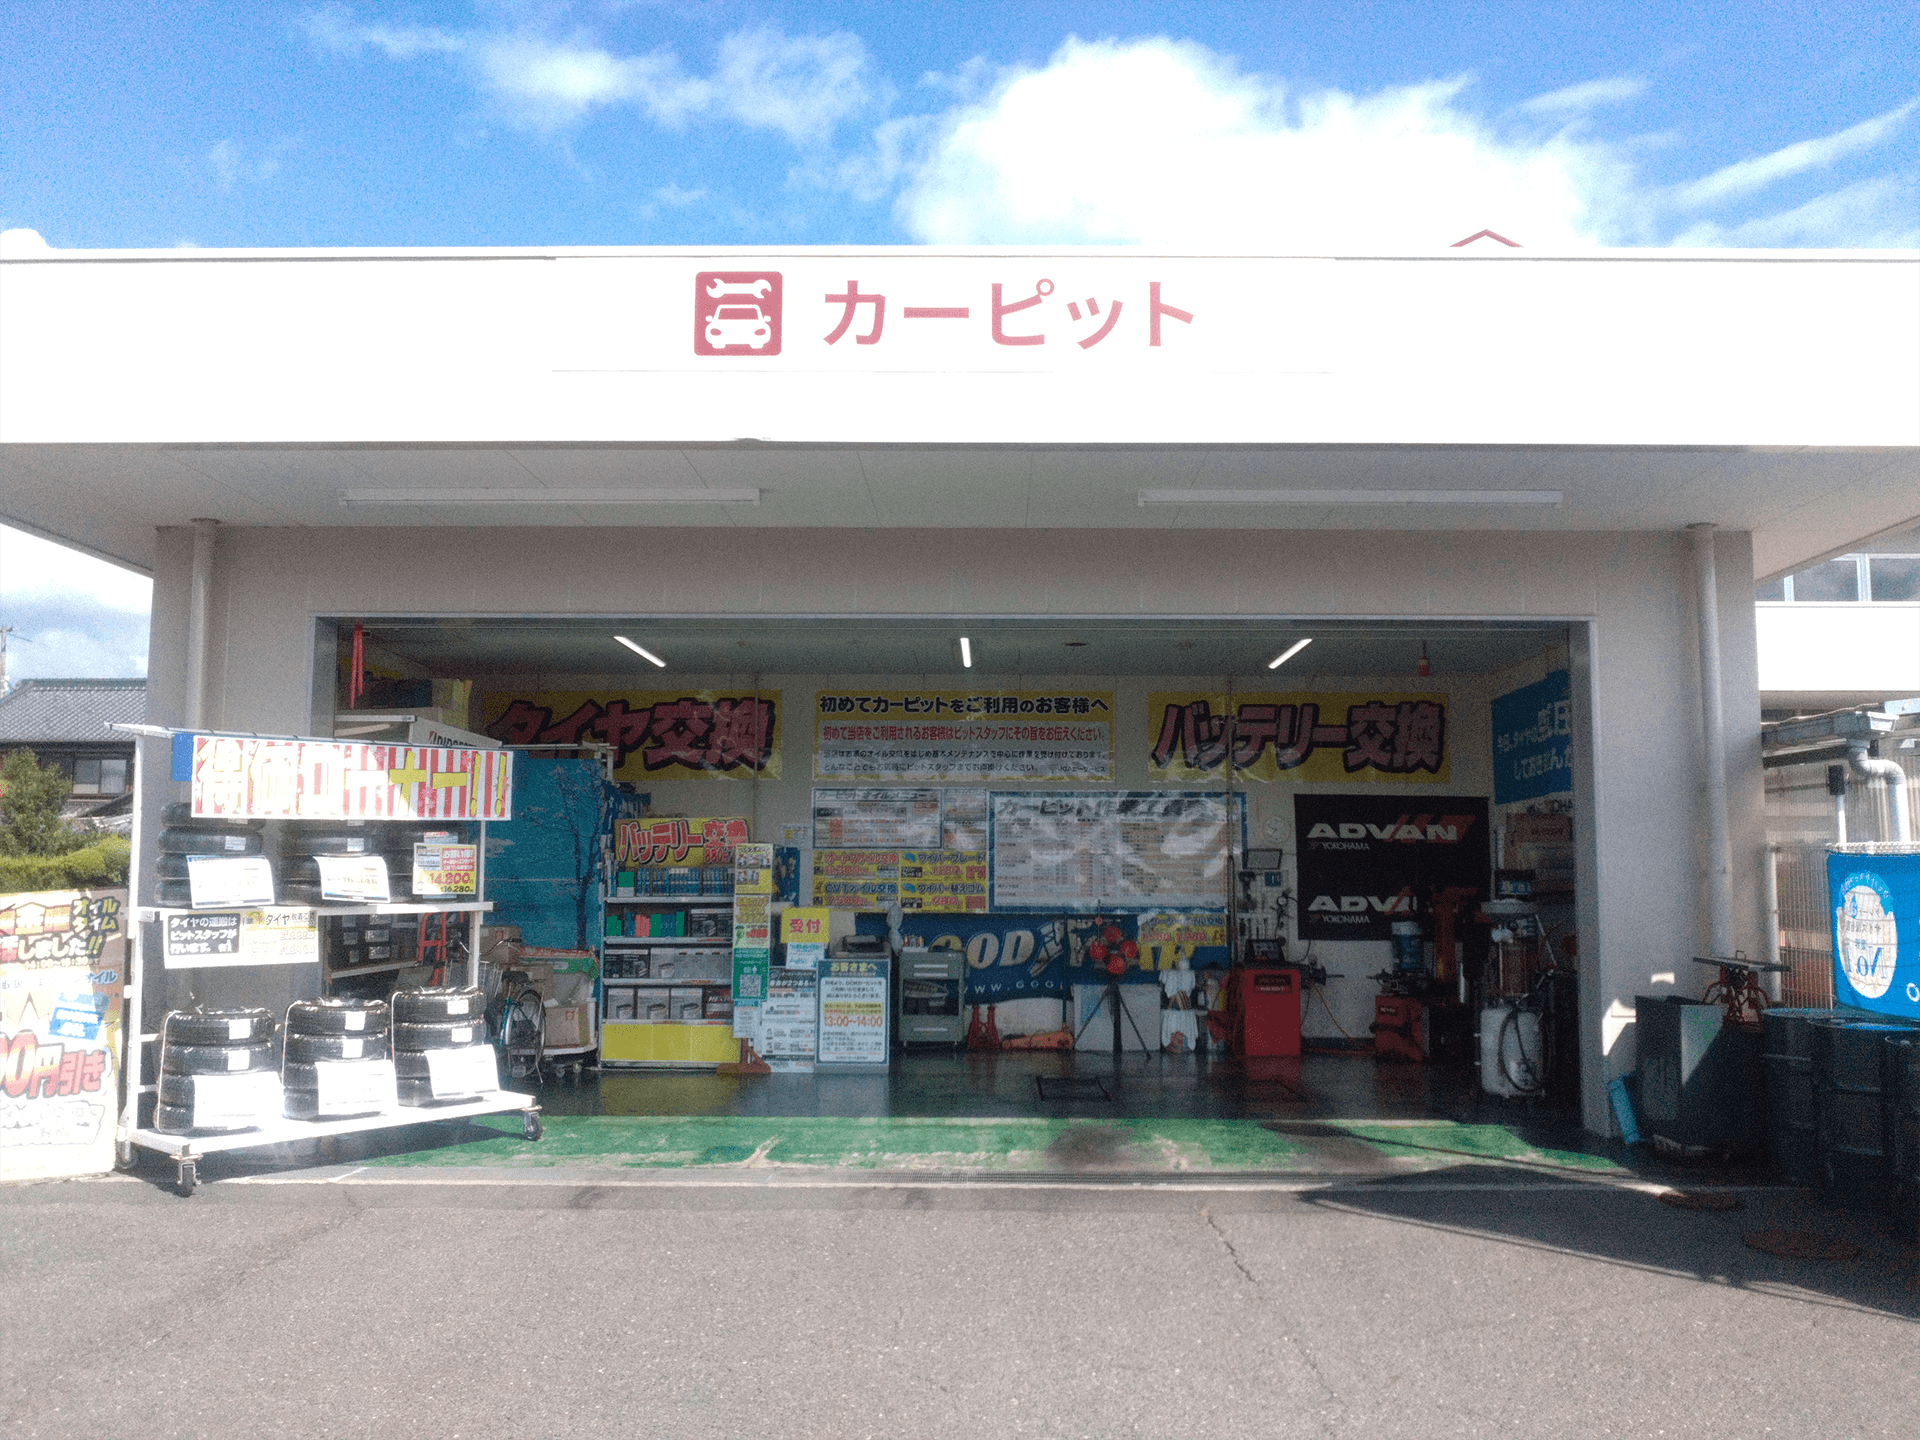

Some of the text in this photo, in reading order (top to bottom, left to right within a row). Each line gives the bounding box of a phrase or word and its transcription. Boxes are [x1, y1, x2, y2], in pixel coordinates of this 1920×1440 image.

[823, 278, 1194, 350] カーピット
[819, 695, 1110, 714] 初めてカーピットをご利用のお客様へ
[485, 698, 776, 771] タイヤ交換
[1151, 700, 1445, 774] バッテリー交換
[1307, 822, 1458, 841] ADVAN
[1320, 842, 1371, 851] YOKOHAMA
[917, 851, 986, 864] ワイパーブレード
[825, 883, 898, 895] CVTオイル交換
[71, 897, 121, 916] オイル
[71, 915, 119, 934] タイム
[788, 917, 822, 934] 受付
[1320, 914, 1371, 924] YOKOHAMA
[831, 962, 878, 972] お客さまへ
